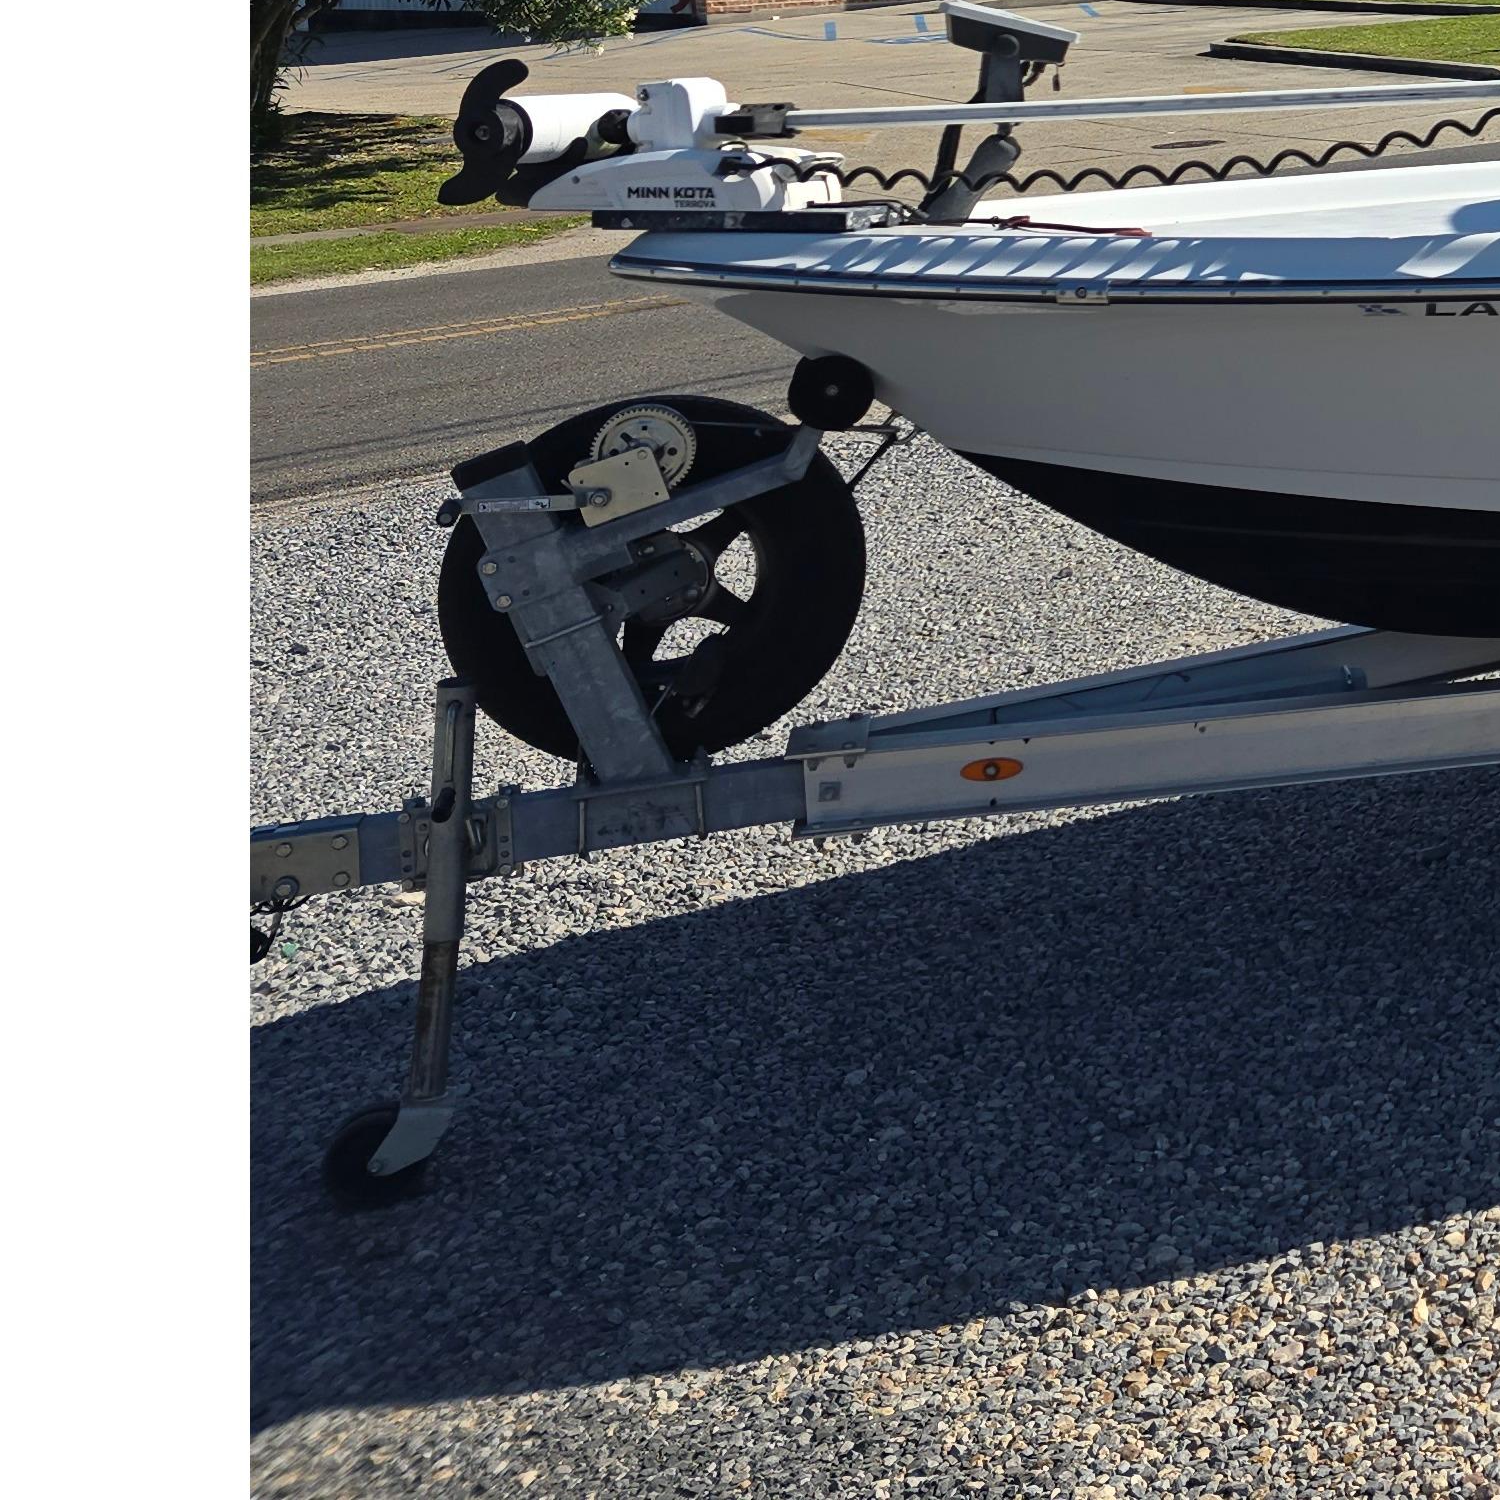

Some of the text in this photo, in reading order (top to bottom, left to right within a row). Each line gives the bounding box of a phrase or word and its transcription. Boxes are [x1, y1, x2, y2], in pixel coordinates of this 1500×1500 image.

[627, 186, 715, 199] MINN KOTA
[1425, 303, 1499, 316] LA
